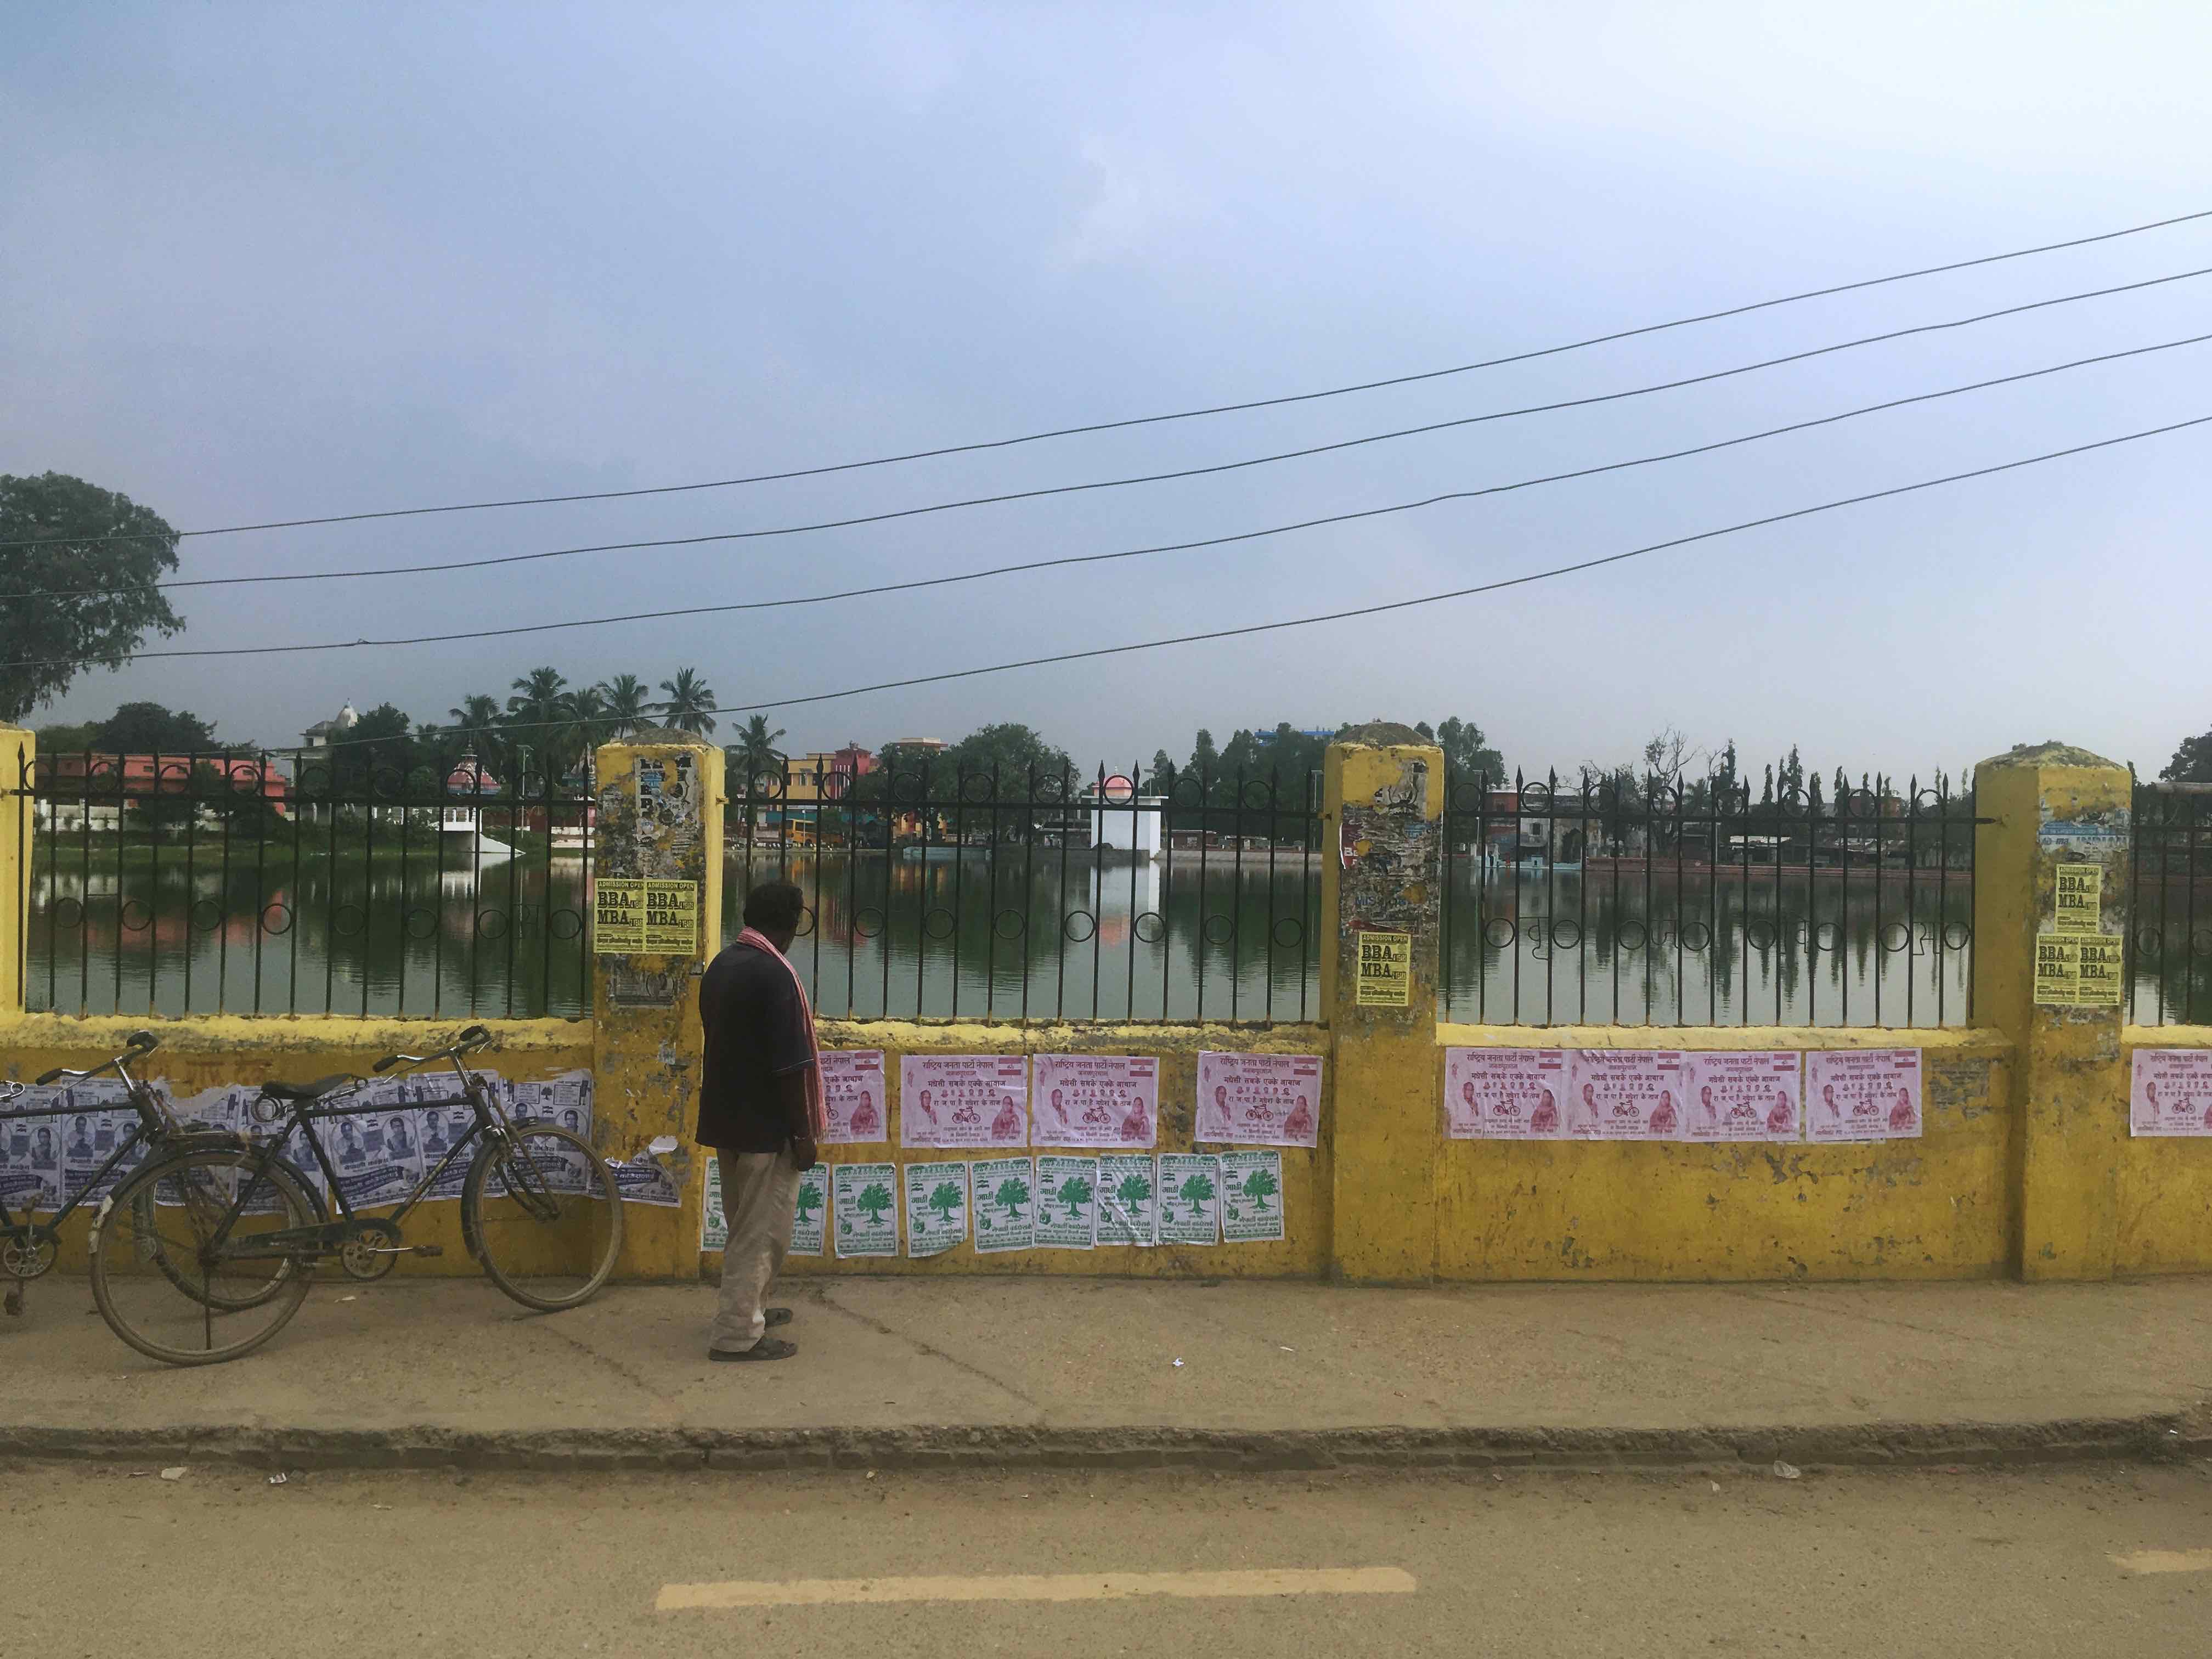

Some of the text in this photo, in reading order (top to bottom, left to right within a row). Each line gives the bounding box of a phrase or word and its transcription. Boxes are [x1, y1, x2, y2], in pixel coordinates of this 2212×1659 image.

[2059, 877, 2085, 892] BBA
[597, 891, 630, 909] BBA
[647, 893, 679, 909] BBA
[2058, 894, 2085, 908] MBA
[597, 910, 629, 925] MBA
[647, 911, 678, 926] MBA
[1362, 945, 1393, 961] BBA
[2038, 946, 2066, 961] BBA
[2080, 947, 2108, 963] BBA
[1361, 963, 1392, 977] MBA
[2038, 963, 2064, 977] MBA
[2080, 965, 2107, 978] MBA
[923, 1059, 941, 1070] राष्ट्रिय
[962, 1058, 974, 1068] पार्टी
[977, 1059, 994, 1069] नेपाल
[1055, 1058, 1073, 1069] राष्ट्रिय
[1094, 1060, 1107, 1069] पार्टी
[1108, 1060, 1125, 1070] नेपाल
[1220, 1056, 1289, 1068] राष्ट्रिय जनता पार्टी नेपाल
[1466, 1052, 1485, 1062] राष्ट्रिय
[1505, 1052, 1516, 1062] पार्टी
[1519, 1054, 1536, 1062] नेपाल
